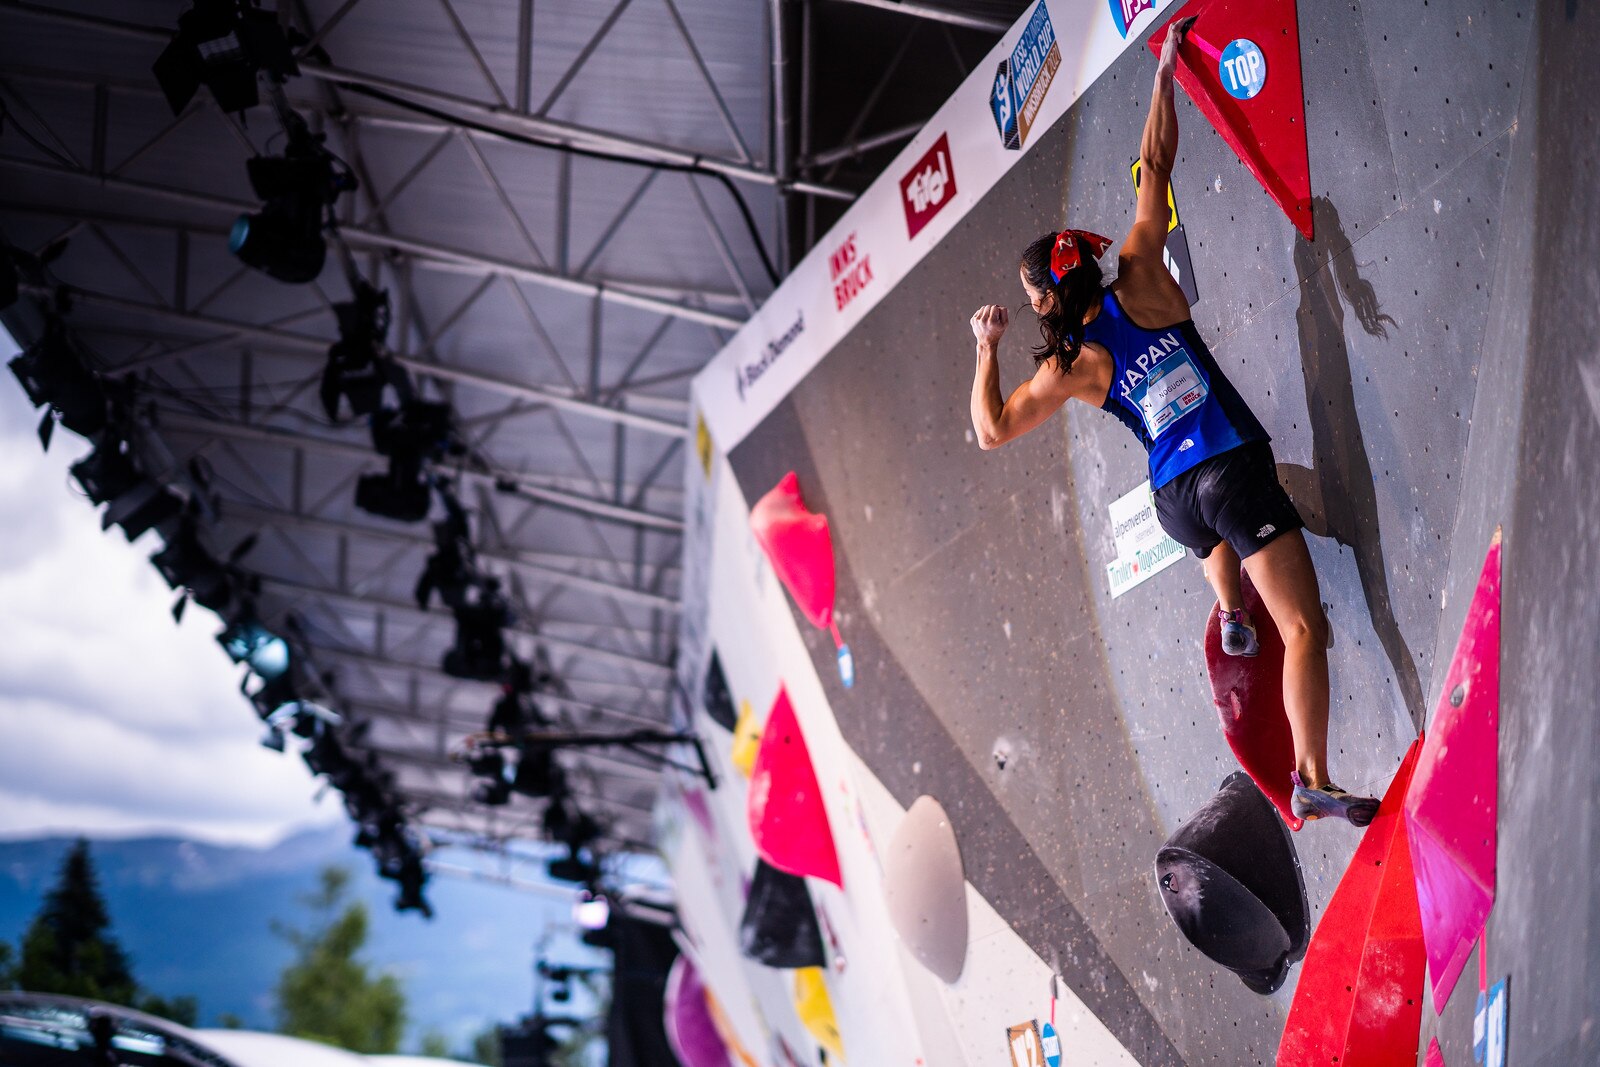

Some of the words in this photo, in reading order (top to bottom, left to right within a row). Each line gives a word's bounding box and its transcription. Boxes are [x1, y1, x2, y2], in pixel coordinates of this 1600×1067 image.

[1013, 38, 1028, 72] IFSC
[1016, 45, 1041, 101] WORLD
[1037, 20, 1053, 57] CUP
[1224, 51, 1260, 91] TOP
[1023, 67, 1051, 126] INNSBRUCK
[832, 254, 874, 312] BRUCK
[1120, 332, 1180, 397] JAPAN
[1159, 377, 1187, 399] NOGUCHI
[1184, 393, 1201, 406] BRUCK
[1114, 505, 1152, 539] alpenverein
